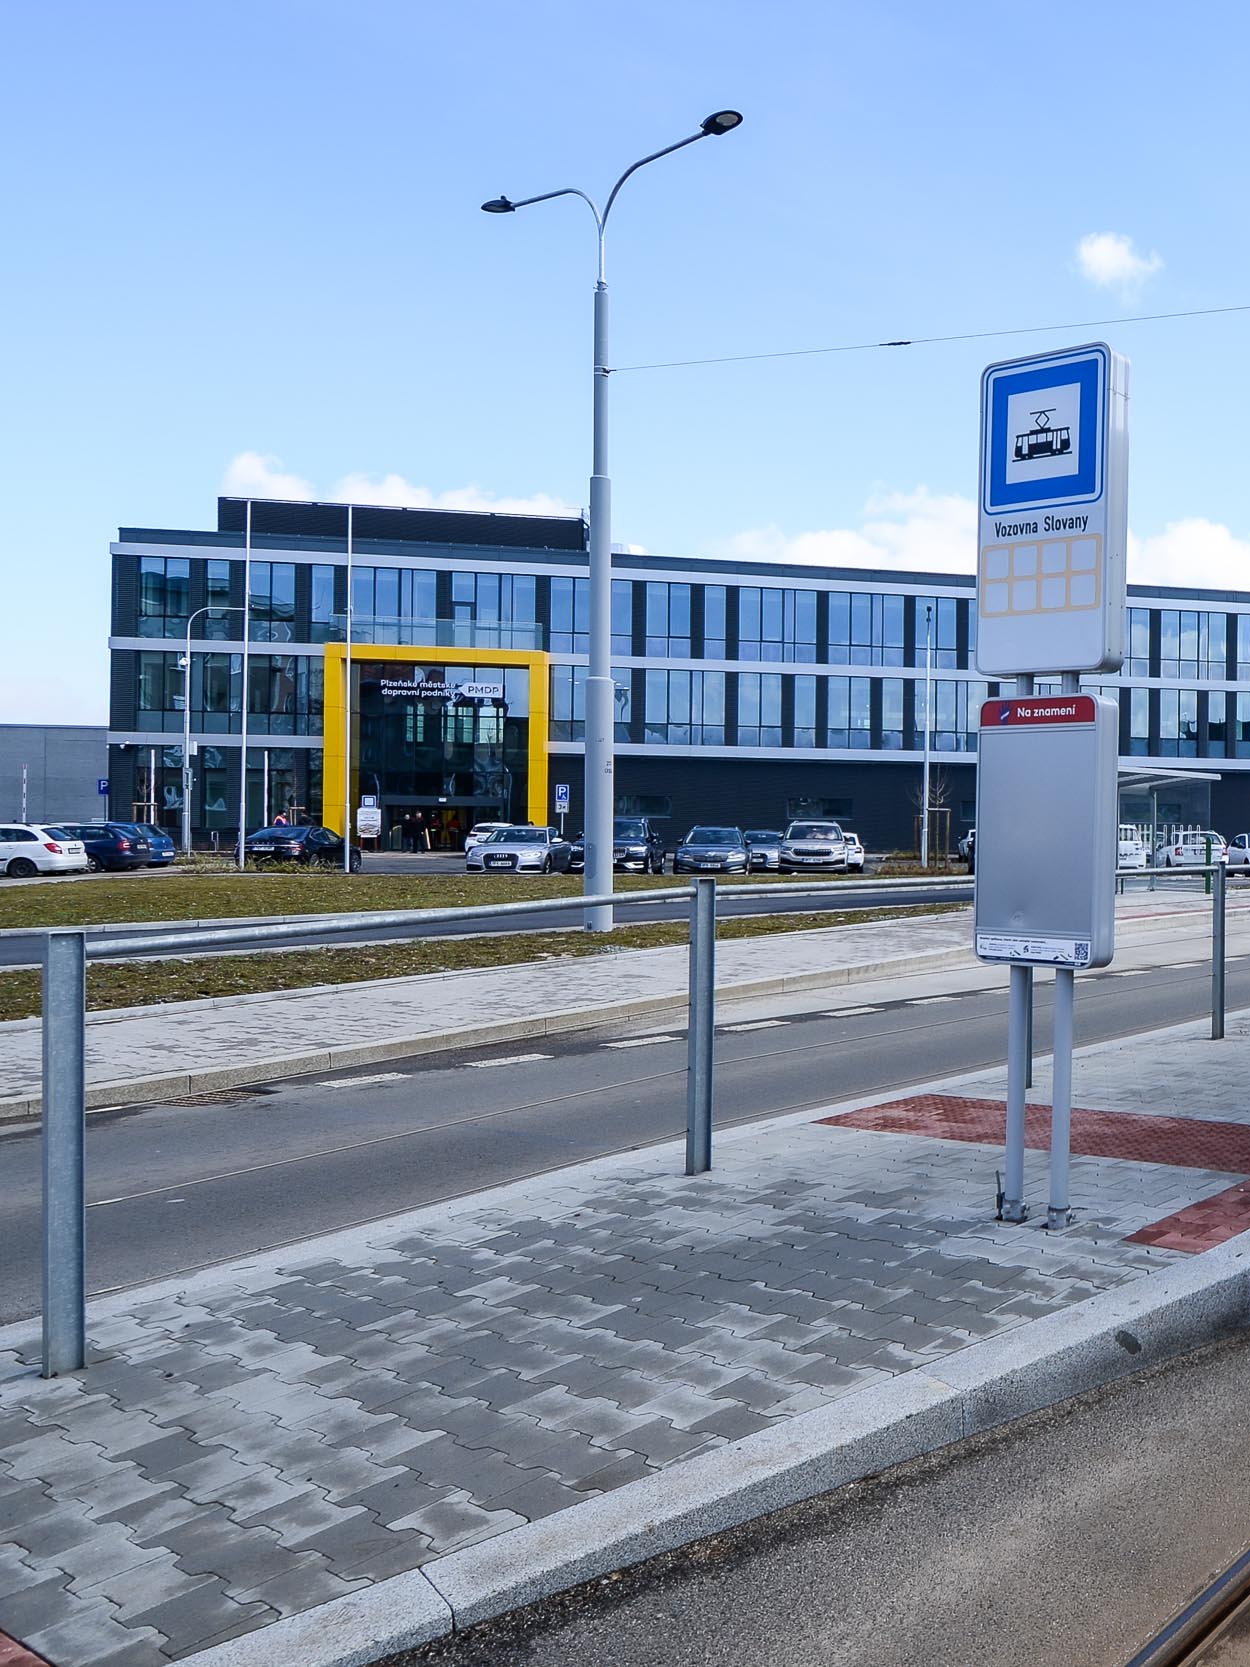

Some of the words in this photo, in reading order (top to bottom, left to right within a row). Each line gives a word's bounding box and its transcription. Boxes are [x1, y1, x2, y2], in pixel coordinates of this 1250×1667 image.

[994, 521, 1038, 538] Vozovna
[1044, 515, 1088, 532] Slovany
[381, 688, 419, 696] dopravní
[421, 689, 455, 698] podniky
[467, 685, 500, 694] PMDP
[1017, 707, 1031, 717] Na
[1033, 704, 1076, 717] znamení
[100, 780, 109, 790] P
[558, 786, 567, 797] P
